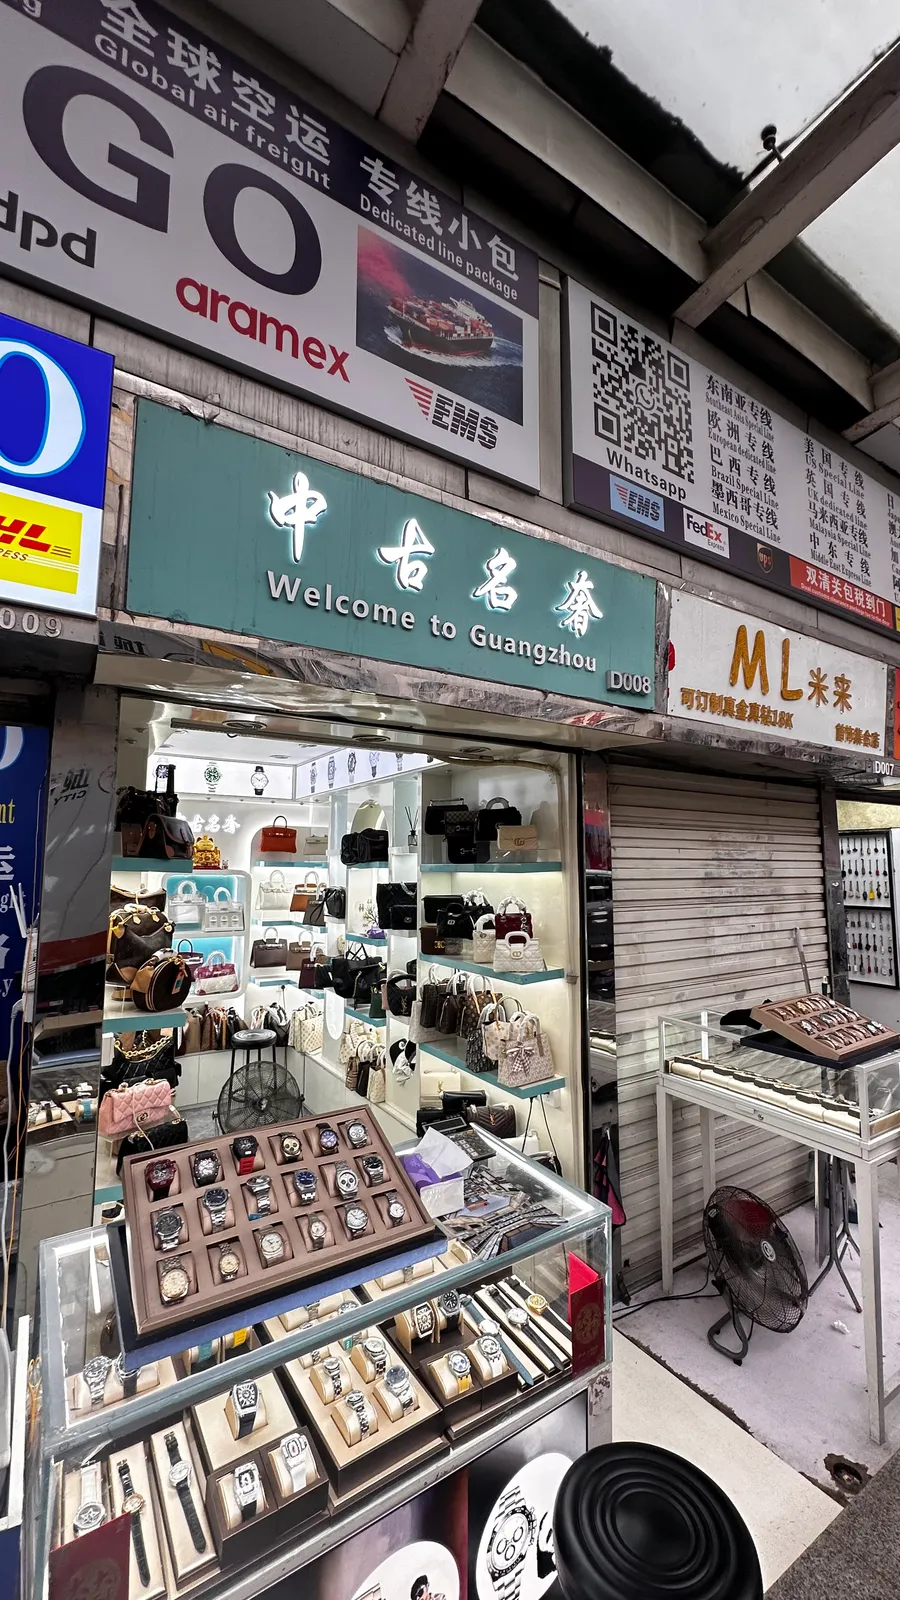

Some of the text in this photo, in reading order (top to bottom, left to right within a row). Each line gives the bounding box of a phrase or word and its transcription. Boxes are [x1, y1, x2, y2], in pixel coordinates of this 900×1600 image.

[101, 0, 331, 166] 全球空运
[94, 34, 331, 190] Global air freight
[23, 65, 323, 296] GO
[360, 155, 519, 281] 专线小包
[360, 193, 518, 300] Dedicated line package
[175, 277, 351, 383] aramex
[431, 392, 499, 450] EMS
[705, 374, 773, 431] 东南亚专线
[705, 391, 775, 443] Southeast Asia Special Line
[707, 408, 775, 464] 欧洲专线
[707, 426, 777, 475] European dedicated line
[606, 447, 687, 501] Whatsapp
[709, 443, 777, 497] 巴西专线
[711, 464, 779, 509] Brazil Special Line
[804, 437, 864, 490] 美国专线
[805, 454, 865, 500] US Special Line
[628, 490, 661, 522] EMS
[711, 479, 778, 530] 墨西哥专线
[805, 468, 867, 520] 英国专线
[807, 487, 868, 530] UK dedicated line
[686, 513, 723, 544] FedEx
[707, 539, 725, 552] Express
[712, 501, 781, 544] Mexico Special Line
[807, 499, 869, 548] 马来西亚专线
[809, 517, 872, 560] Malaysia Special Line
[0, 548, 28, 562] ESS
[266, 471, 605, 638] 中古名奢
[759, 552, 771, 568] ups
[809, 532, 871, 577] 中东专线
[810, 548, 829, 567] Middle
[829, 558, 841, 573] East
[861, 574, 872, 588] Line
[806, 565, 886, 618] 双清关包税到门
[267, 570, 597, 672] Welcome to Guangzhou
[606, 669, 652, 694] D008
[730, 624, 803, 701] ML
[873, 760, 895, 776] D007
